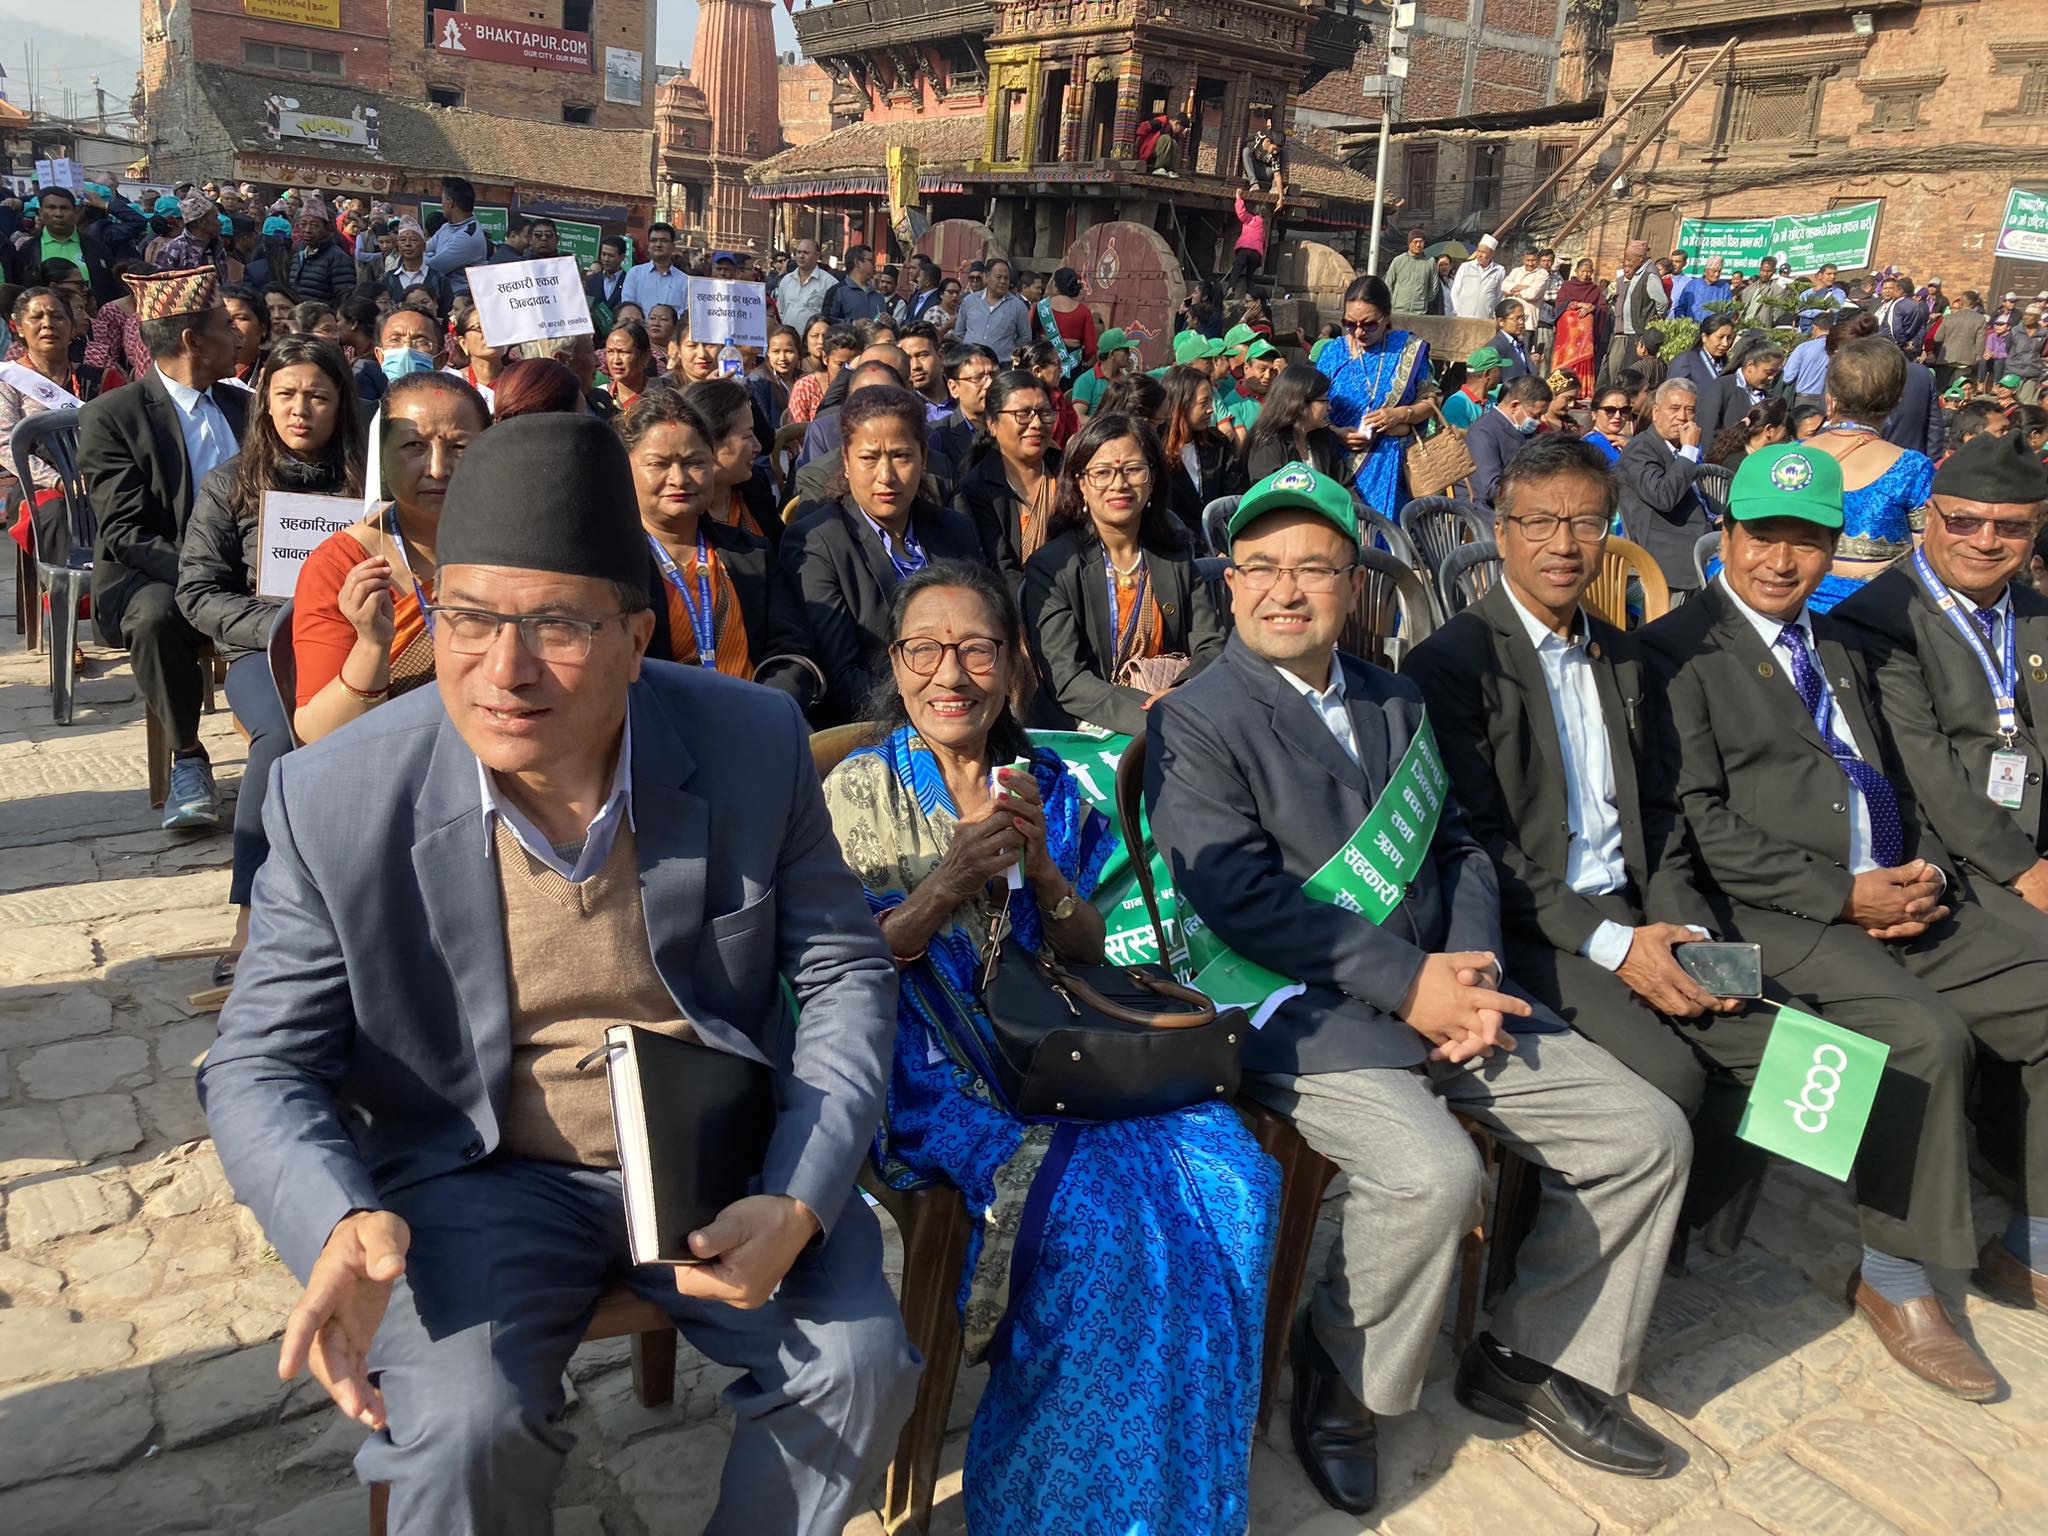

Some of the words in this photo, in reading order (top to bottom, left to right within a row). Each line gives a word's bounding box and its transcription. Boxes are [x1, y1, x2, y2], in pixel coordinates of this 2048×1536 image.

[475, 25, 588, 55] BHAKTAPUR.COM
[523, 50, 538, 58] OUR
[569, 56, 588, 65] PRIDE
[496, 276, 534, 294] सहकारी
[535, 276, 560, 287] एकता
[509, 295, 551, 310] जिन्दावाद
[272, 547, 314, 561] स्वावल
[702, 609, 710, 623] Saving
[1403, 785, 1426, 823] बचत
[1391, 809, 1416, 843] तथा
[1373, 830, 1405, 870] ऋण
[1343, 843, 1399, 906] सहकारी
[1105, 918, 1177, 967] संस्था
